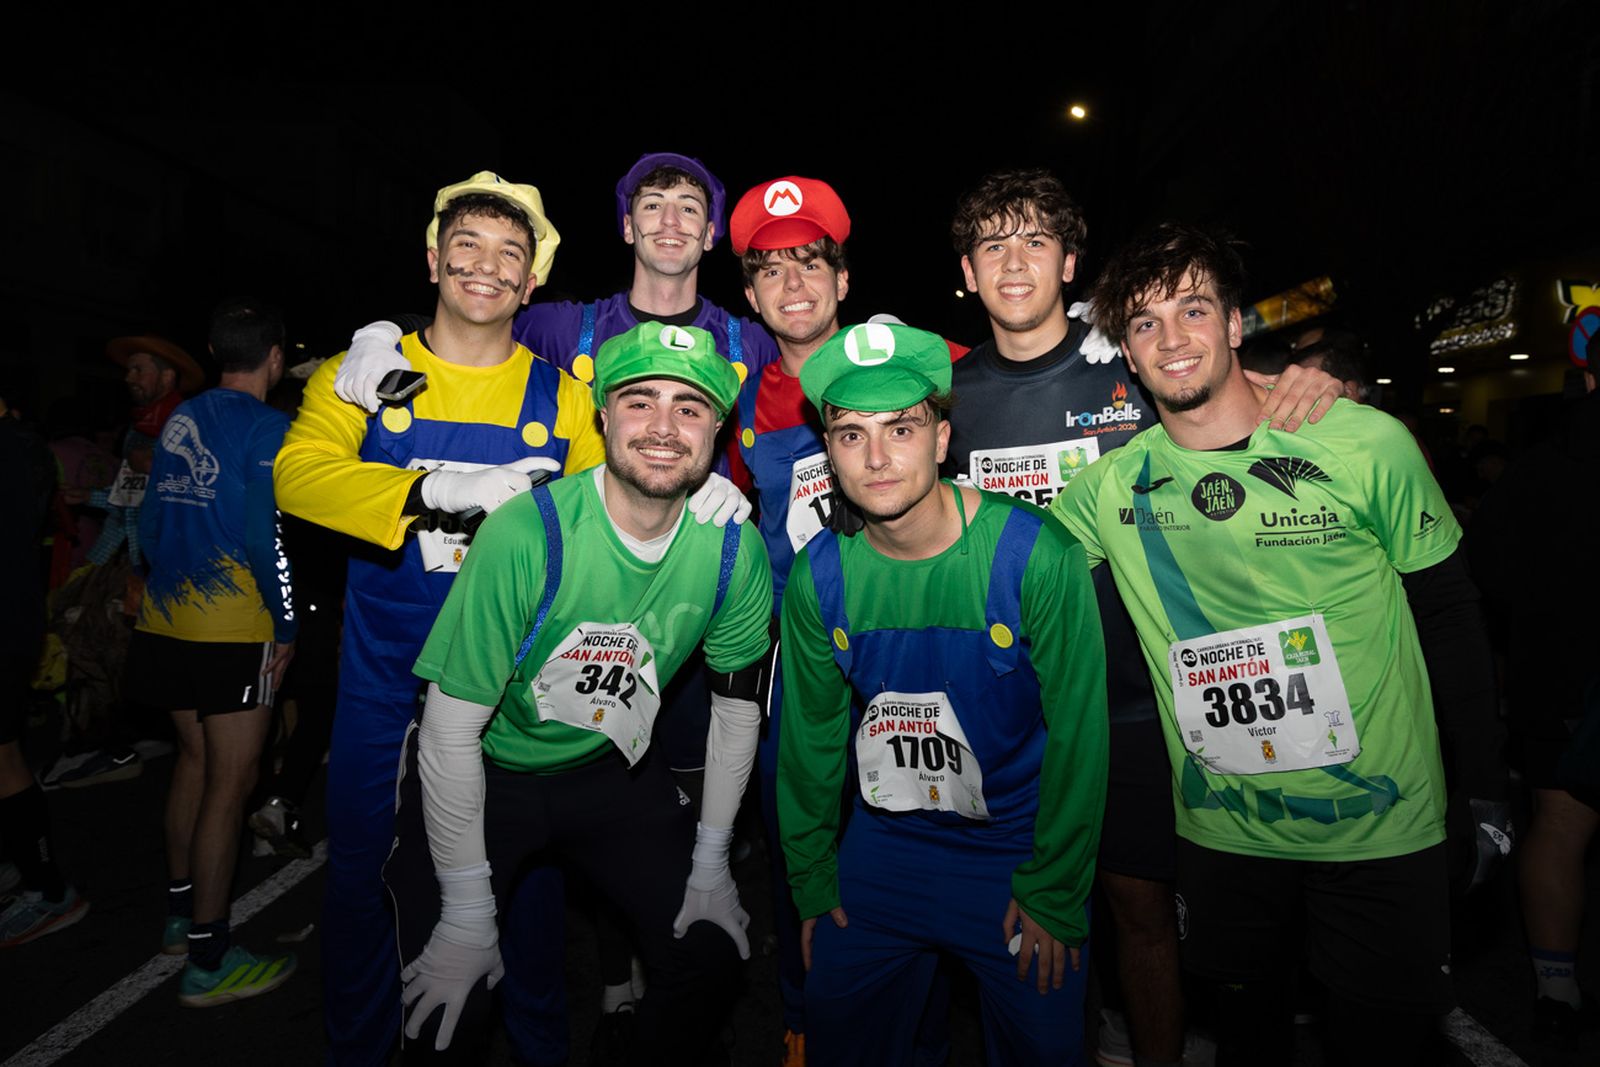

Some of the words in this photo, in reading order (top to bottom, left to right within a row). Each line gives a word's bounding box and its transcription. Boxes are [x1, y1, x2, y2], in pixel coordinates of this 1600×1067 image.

[769, 188, 800, 209] M
[670, 329, 689, 349] L
[853, 326, 889, 362] L
[1066, 403, 1141, 427] IronBells
[1118, 423, 1137, 432] 2026
[994, 461, 1032, 474] NOCHE
[1033, 459, 1047, 470] DE
[984, 477, 1005, 489] SAN
[1007, 471, 1049, 488] ANTÓN
[1200, 479, 1233, 498] JAÉN,
[794, 484, 811, 500] AN
[1136, 507, 1175, 525] Jaén
[1260, 506, 1339, 528] Unicaja
[1256, 535, 1319, 547] Fundación
[1321, 532, 1347, 545] Jaén
[583, 635, 626, 648] NOCHE
[626, 638, 638, 655] DE
[1200, 646, 1244, 666] NOCHE
[1246, 642, 1265, 657] DE
[592, 648, 635, 668] ANTÓN
[1188, 668, 1216, 687] SAN
[1219, 658, 1270, 683] ANTÓN
[575, 664, 637, 710] 342
[589, 696, 616, 709] Álvaro
[1202, 672, 1315, 728] 3834
[882, 705, 921, 718] NOCHE
[924, 706, 940, 718] DE
[869, 719, 895, 737] SAN
[886, 735, 962, 775] 1709
[919, 771, 945, 782] Álvaro
